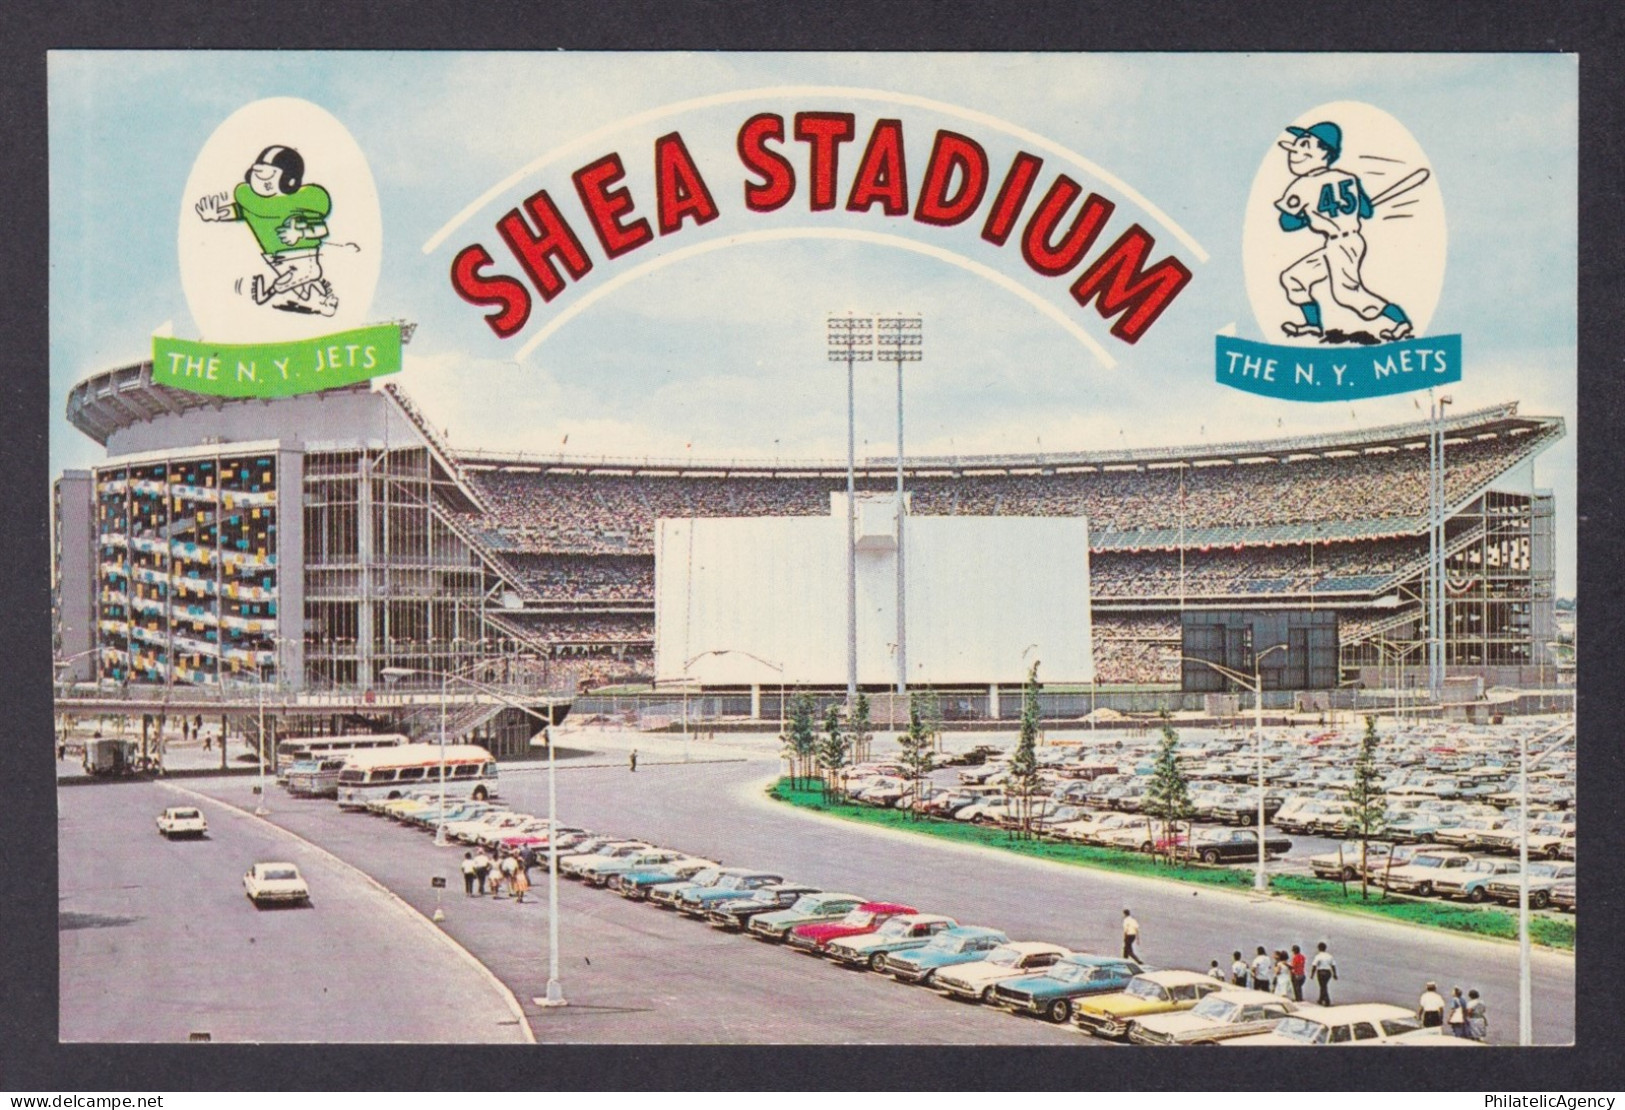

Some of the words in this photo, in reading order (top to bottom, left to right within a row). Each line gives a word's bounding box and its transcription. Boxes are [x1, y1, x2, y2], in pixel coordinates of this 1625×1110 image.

[1316, 178, 1359, 218] 45
[450, 130, 720, 339] SHEA
[736, 111, 1193, 346] STADIUM
[167, 352, 221, 381] THE
[315, 344, 377, 372] JETS
[1226, 350, 1279, 382] THE
[1373, 349, 1447, 380] METS
